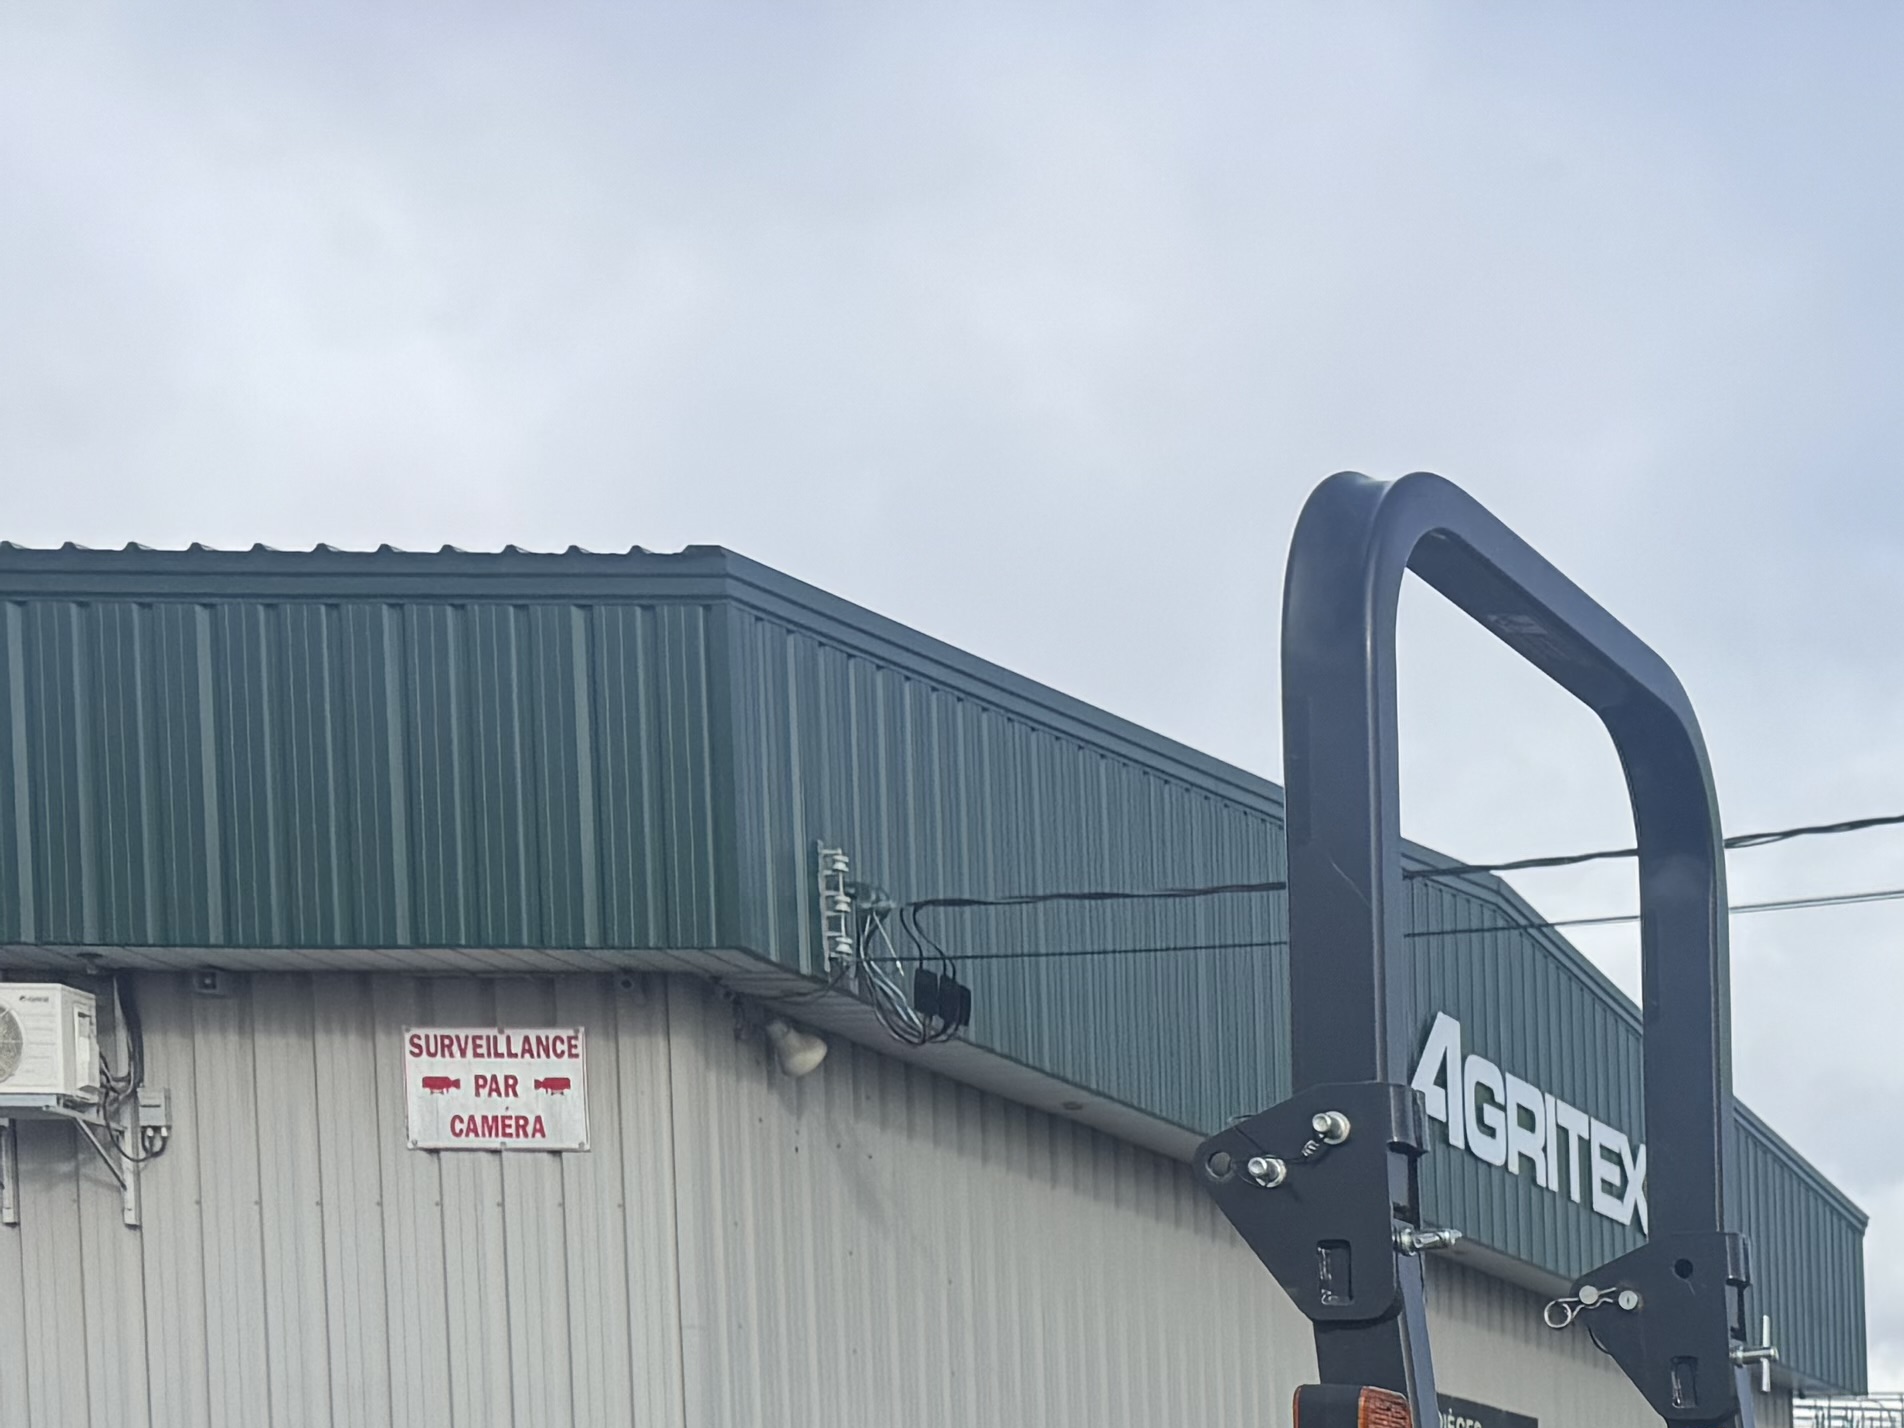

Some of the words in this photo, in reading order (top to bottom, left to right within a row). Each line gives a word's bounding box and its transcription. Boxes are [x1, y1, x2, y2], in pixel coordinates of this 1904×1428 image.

[408, 1033, 580, 1059] SURVEILLANCE
[473, 1073, 519, 1098] PAR
[1410, 1010, 1649, 1238] AGRITEX
